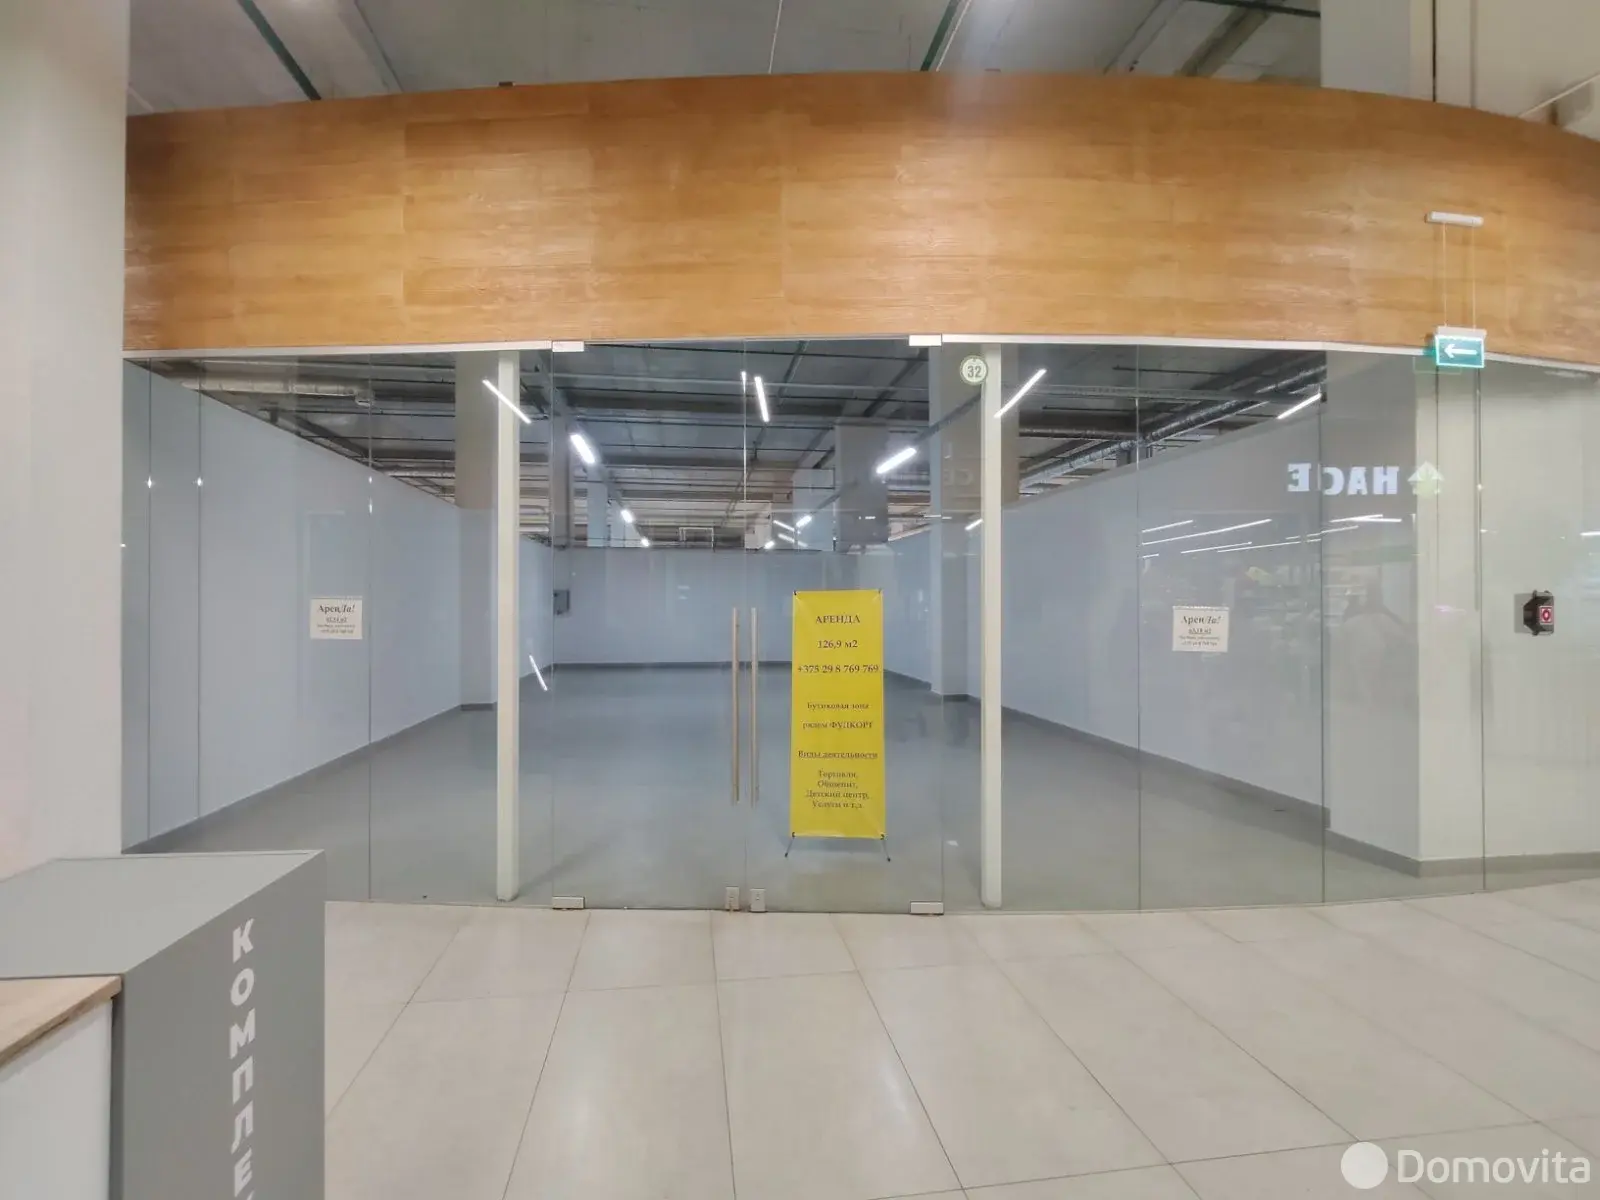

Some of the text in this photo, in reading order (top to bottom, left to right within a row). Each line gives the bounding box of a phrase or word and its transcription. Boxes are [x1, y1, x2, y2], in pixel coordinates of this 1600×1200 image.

[967, 366, 981, 378] 32
[816, 614, 861, 624] АРЕНДА
[817, 639, 858, 649] 126,9 м2
[797, 664, 879, 674] +375 29 8 769 769
[829, 720, 873, 730] ФУДКОРТ
[229, 918, 256, 1200] КОМПЛЕ
